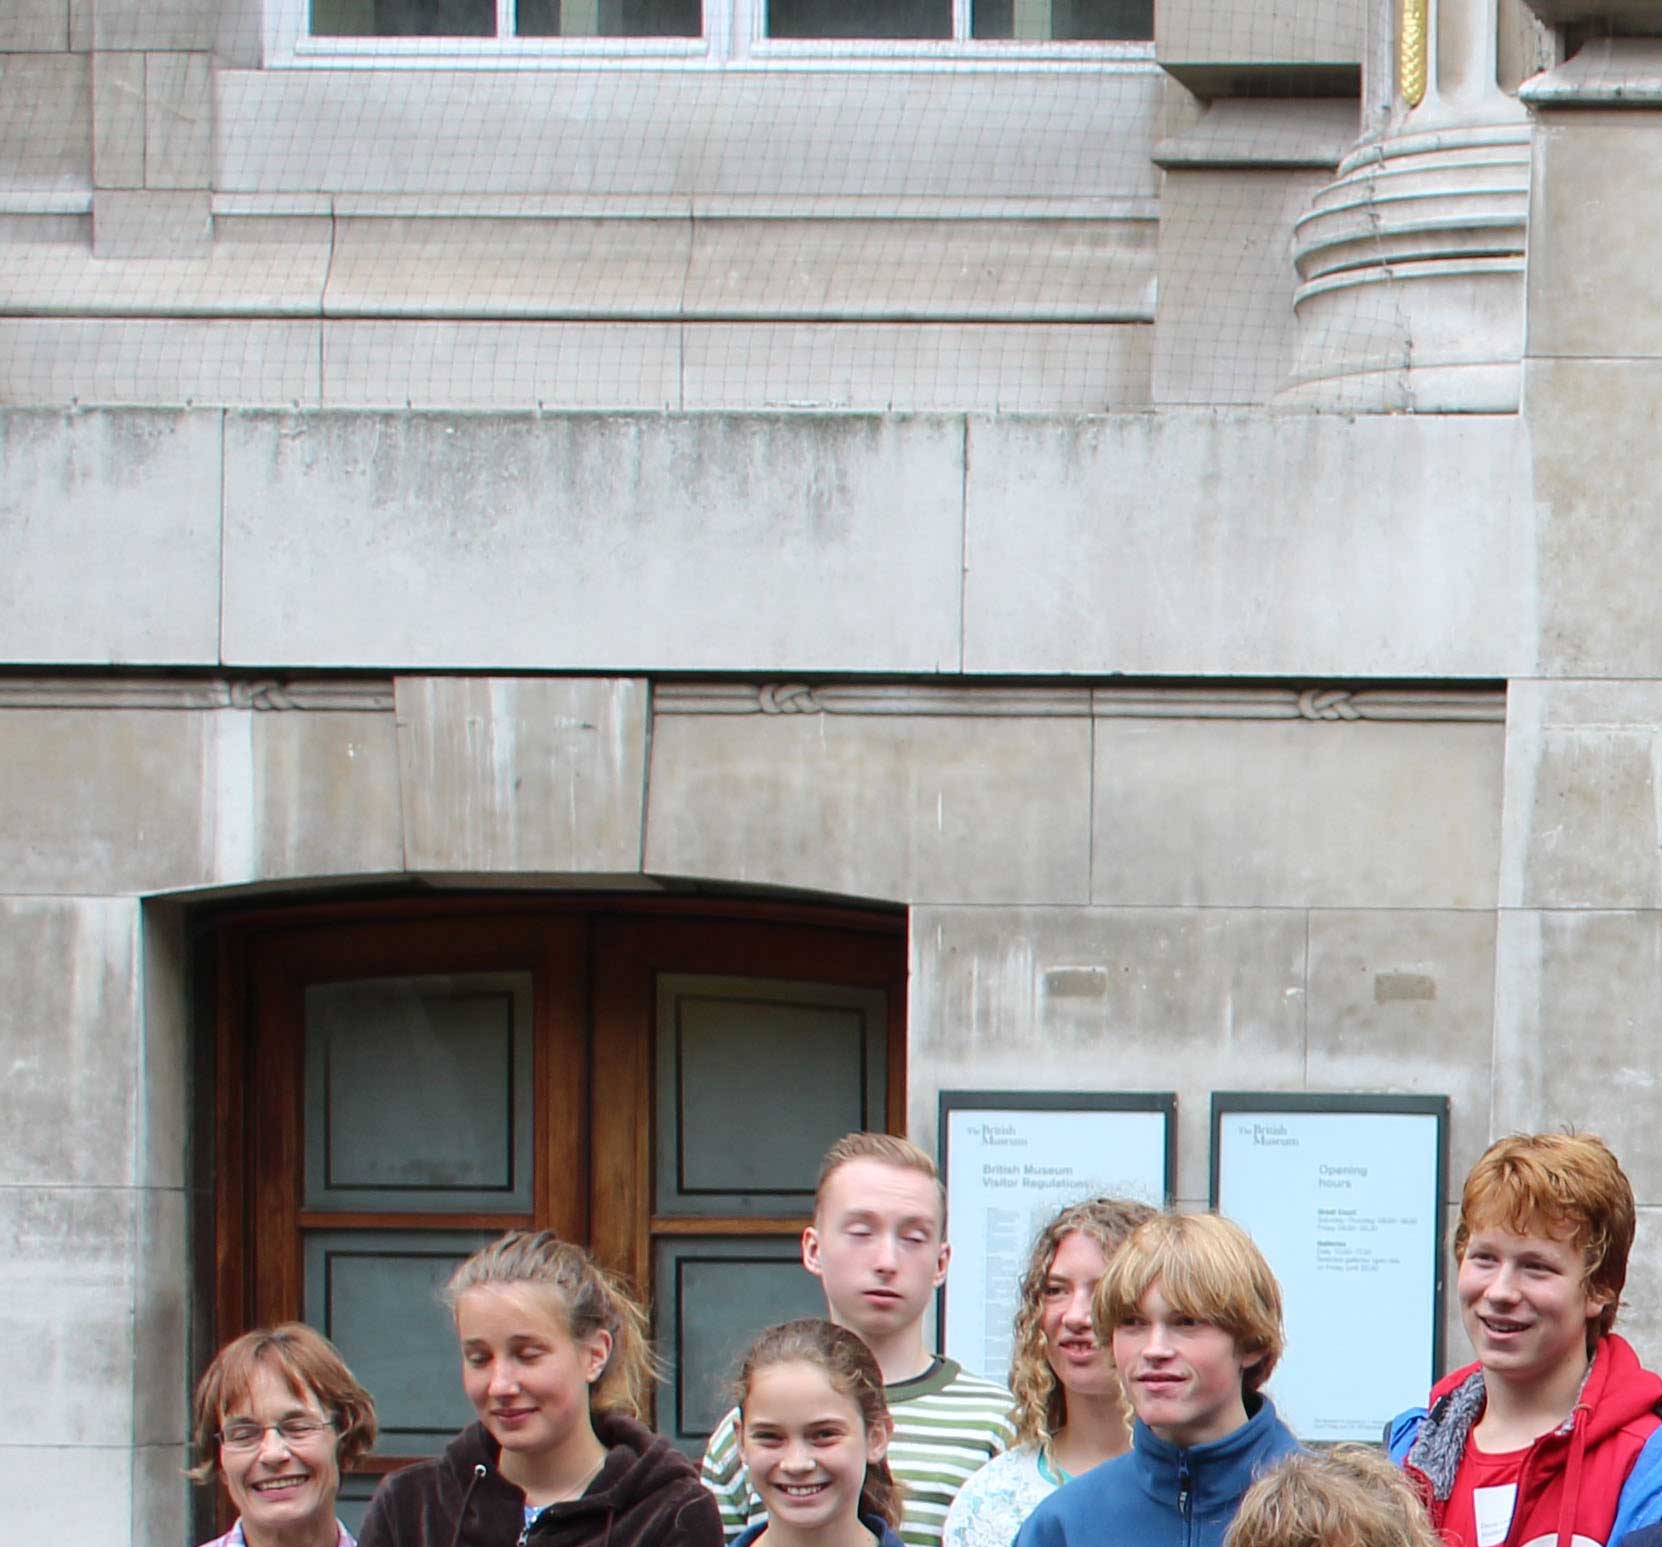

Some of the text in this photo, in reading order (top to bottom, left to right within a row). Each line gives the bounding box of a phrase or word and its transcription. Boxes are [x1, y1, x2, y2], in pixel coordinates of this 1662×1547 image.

[982, 1124, 1017, 1136] British
[1253, 1124, 1288, 1136] British
[982, 1135, 1029, 1147] Museum
[1253, 1135, 1300, 1147] Museum
[982, 1164, 1074, 1175] British Museum
[1318, 1164, 1369, 1178] Opening
[982, 1177, 1019, 1188] Visitor
[1318, 1177, 1353, 1189] hours
